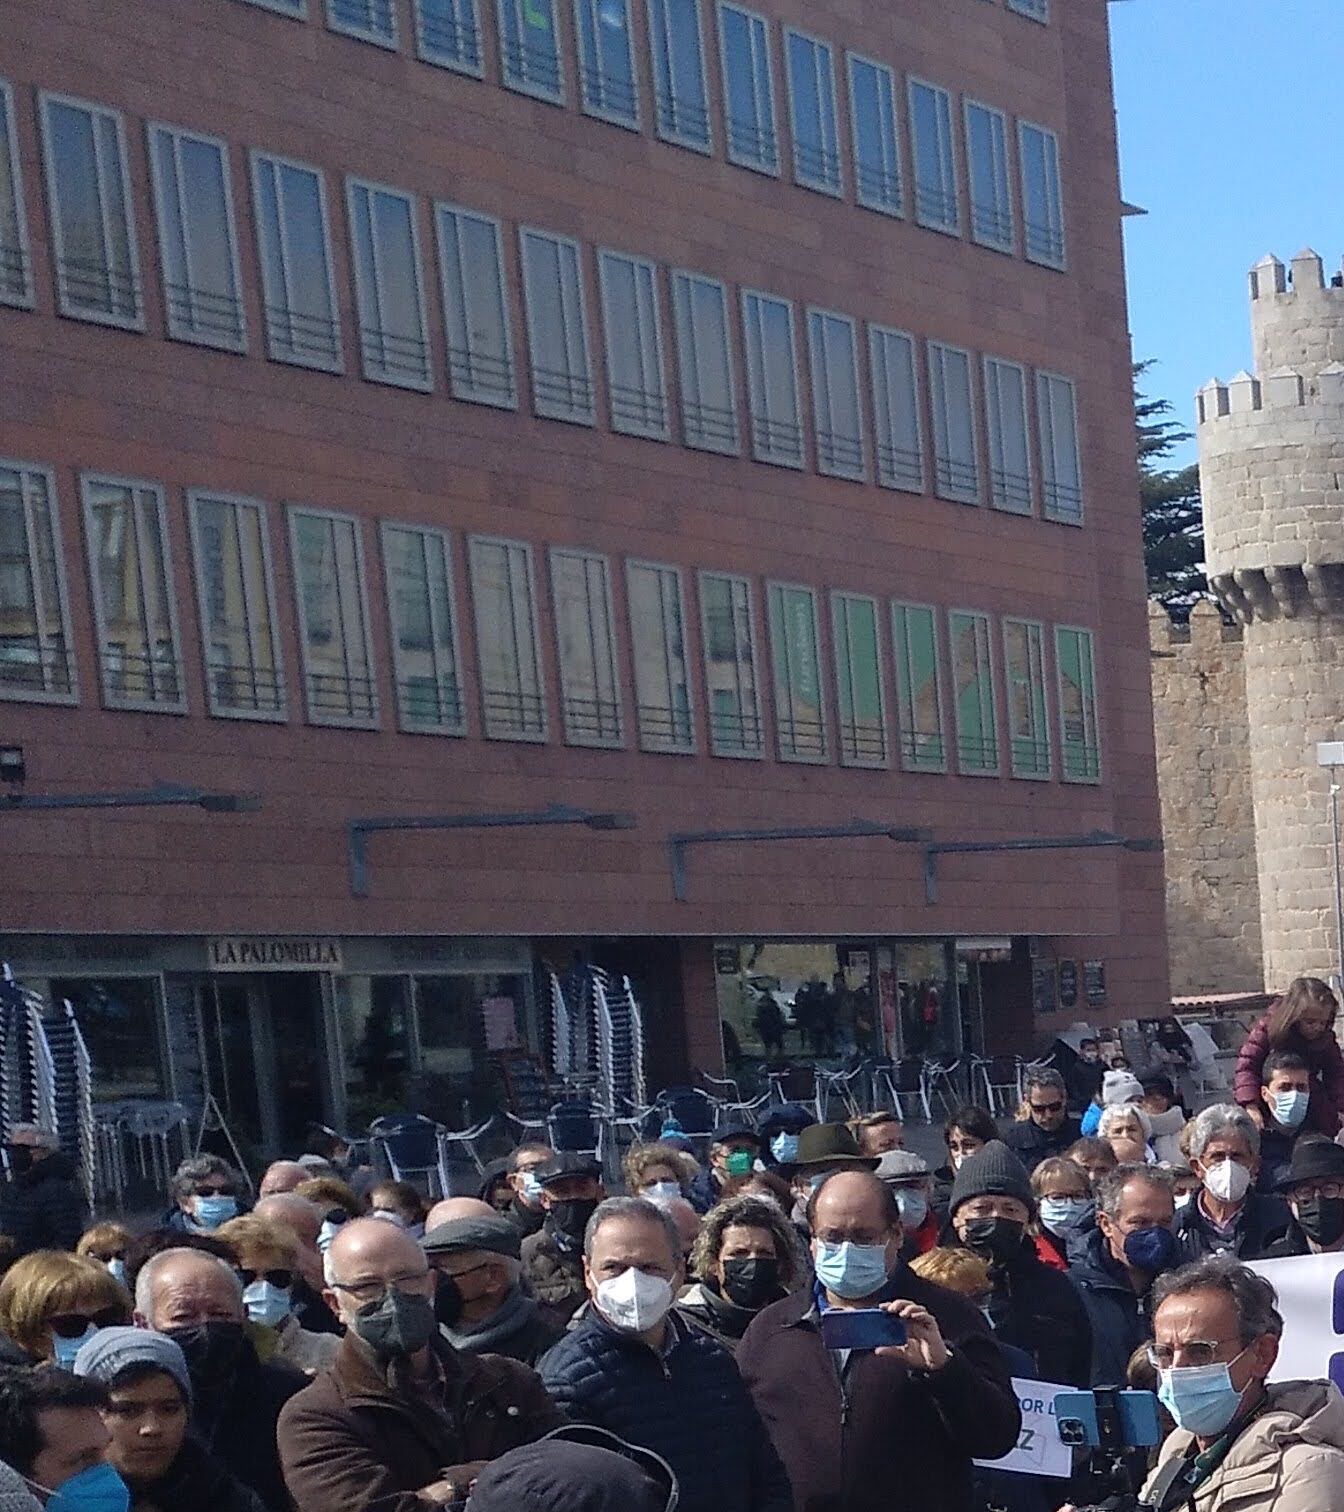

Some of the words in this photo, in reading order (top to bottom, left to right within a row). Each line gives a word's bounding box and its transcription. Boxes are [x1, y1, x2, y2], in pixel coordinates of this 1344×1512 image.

[214, 943, 237, 963] LA
[241, 942, 338, 963] PALOMILLA
[1022, 1399, 1044, 1414] OR
